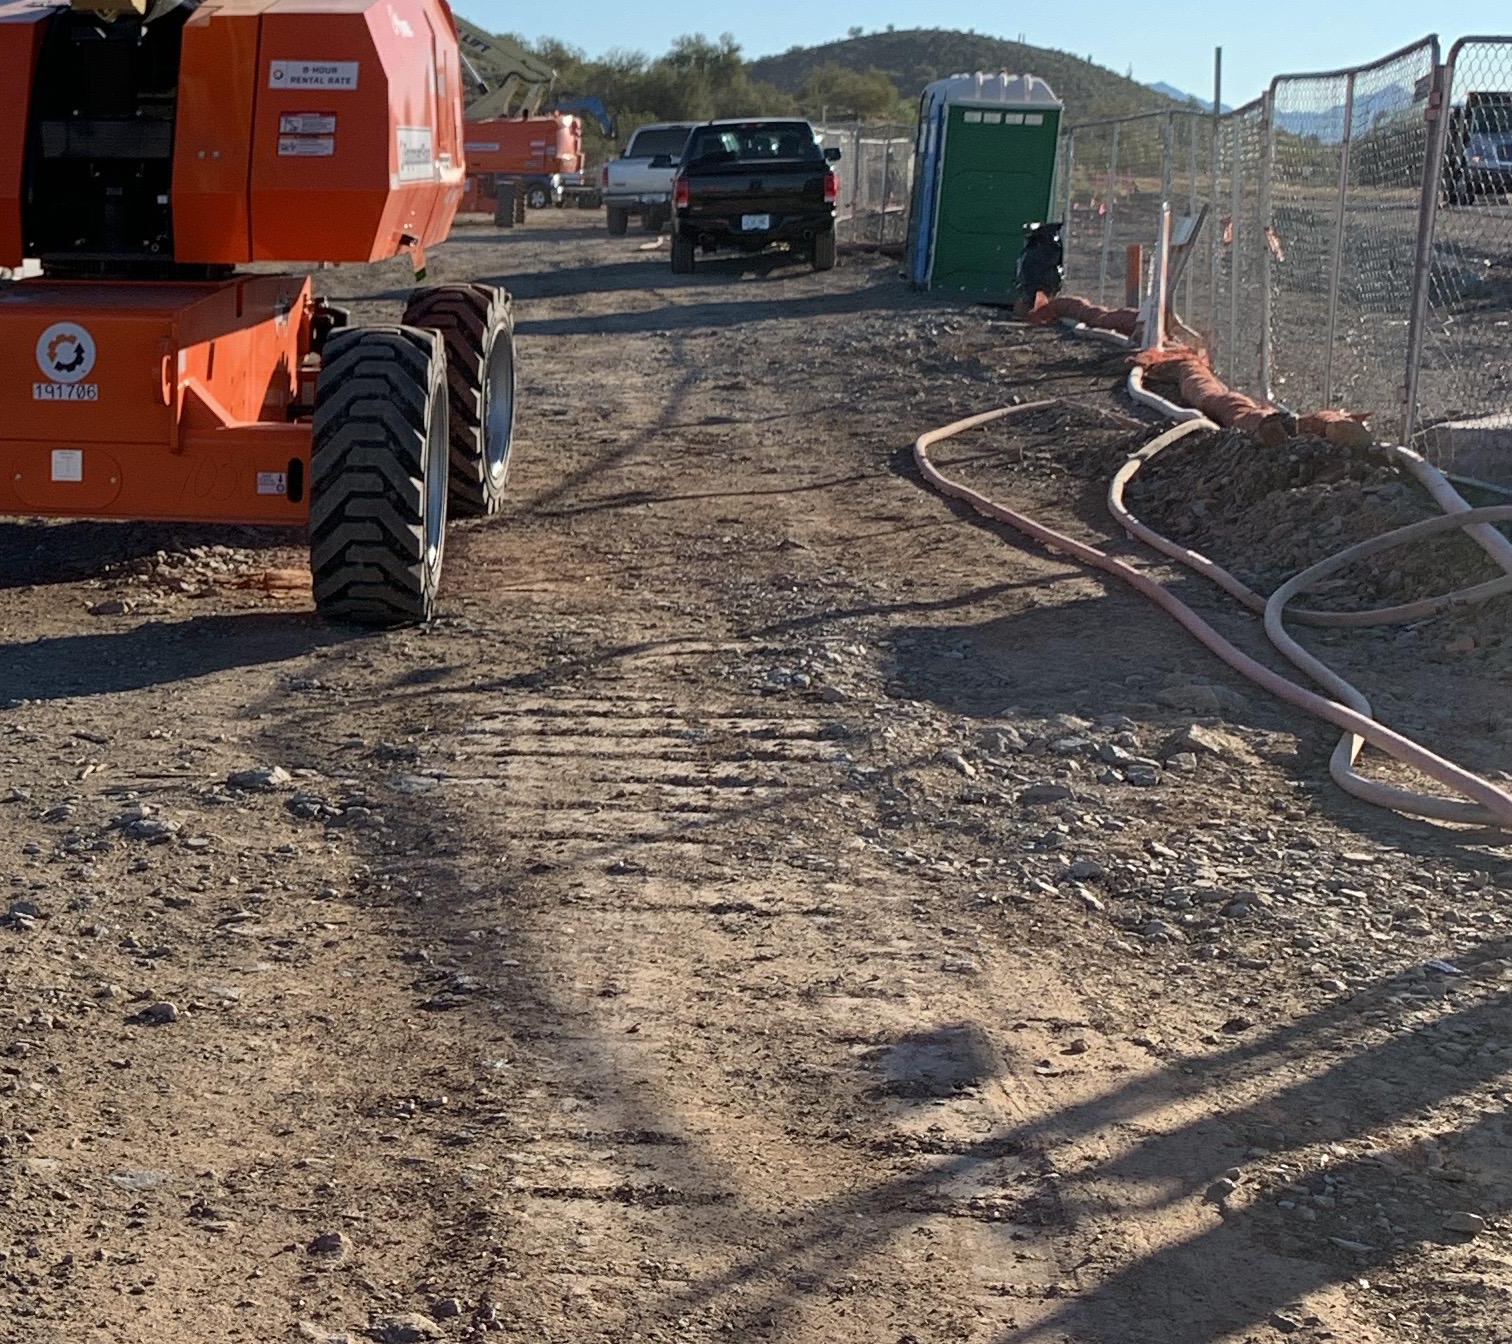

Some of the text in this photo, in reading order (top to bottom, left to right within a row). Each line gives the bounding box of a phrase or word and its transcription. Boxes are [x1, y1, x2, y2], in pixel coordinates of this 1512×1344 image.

[290, 76, 351, 85] RENTAL RATE
[36, 384, 97, 399] 191706
